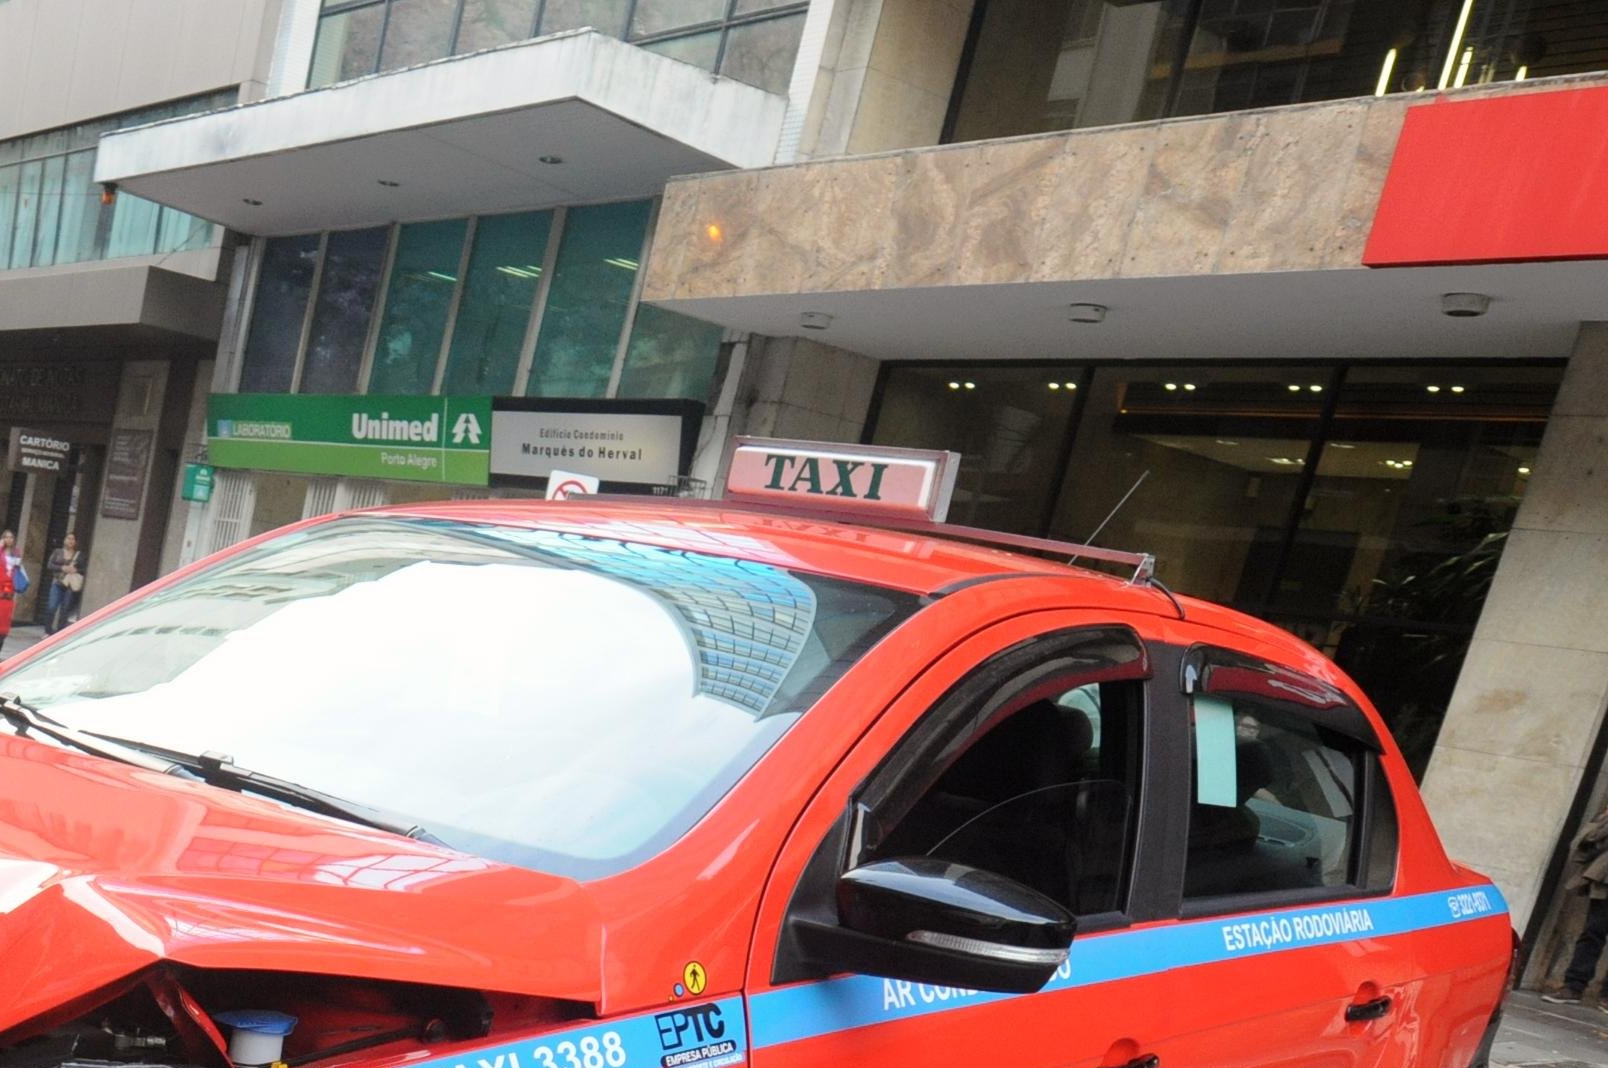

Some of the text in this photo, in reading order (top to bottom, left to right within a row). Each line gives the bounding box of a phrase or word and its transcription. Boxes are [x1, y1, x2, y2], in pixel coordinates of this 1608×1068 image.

[352, 412, 439, 442] Unimed
[20, 435, 70, 452] CARTÓRIO
[579, 446, 593, 457] do
[598, 447, 642, 460] Herval
[381, 452, 437, 470] Porto Alegre
[765, 454, 888, 500] TAXI
[1222, 907, 1374, 951] ESTAÇÃO RODOVIÁRIA
[883, 977, 916, 1011] AR
[654, 1002, 725, 1050] EPTC
[665, 1042, 734, 1067] EMPRESA PÚBLICA
